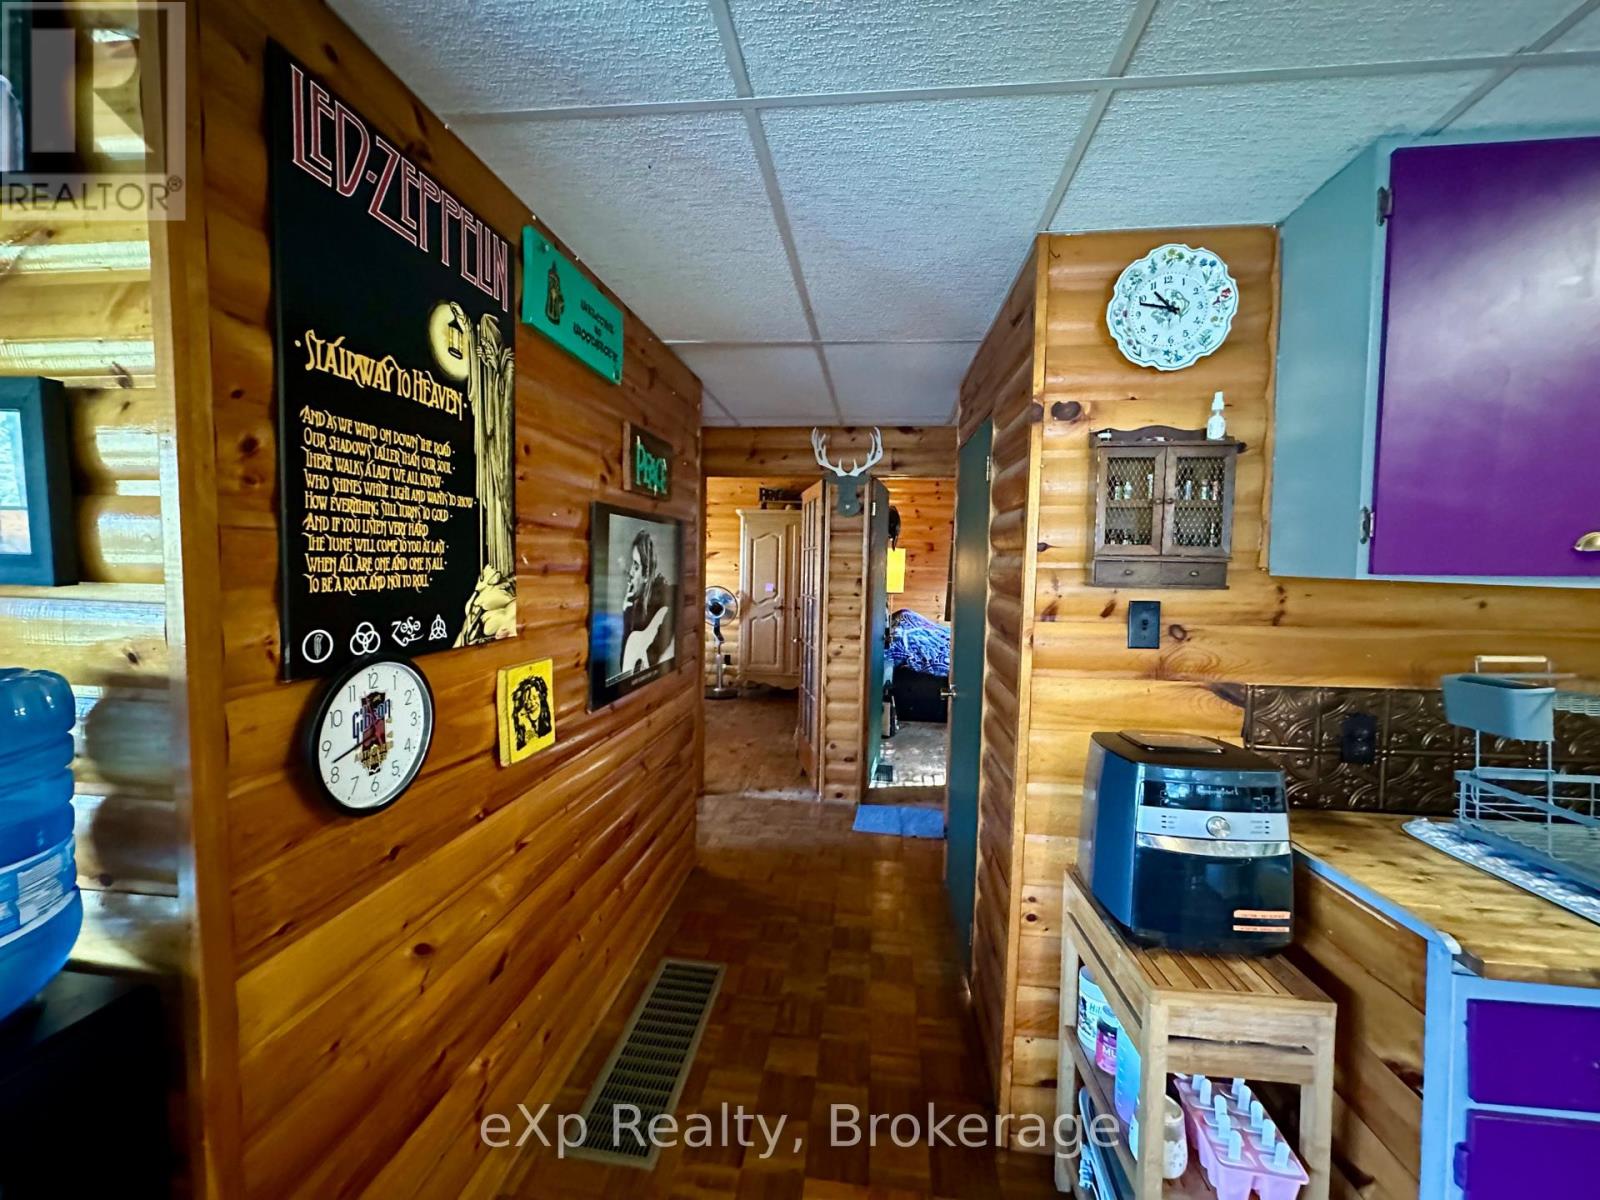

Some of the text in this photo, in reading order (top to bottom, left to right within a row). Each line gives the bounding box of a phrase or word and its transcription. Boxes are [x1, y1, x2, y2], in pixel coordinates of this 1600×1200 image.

[1163, 275, 1173, 285] 12
[1193, 287, 1199, 295] 2
[1152, 334, 1158, 343] 7
[1168, 335, 1174, 344] 6
[1182, 330, 1189, 338] 5
[304, 329, 463, 421] STAIRWAY TO HEAVEN
[300, 404, 326, 428] AND
[323, 409, 338, 433] AS
[337, 416, 353, 435] WE
[353, 420, 378, 440] WIND
[393, 431, 419, 453] DOWN
[303, 426, 331, 455] OUR
[328, 436, 372, 462] SHADOWS
[370, 440, 402, 468] TALLER
[398, 447, 420, 470] THAN
[300, 446, 334, 472] THERE
[334, 456, 364, 480] WALKS
[392, 467, 406, 483] WE
[303, 468, 330, 489] WHO
[332, 477, 362, 497] SHINES
[362, 480, 389, 498] WHITE
[411, 489, 426, 504] AND
[304, 491, 328, 510] HOW
[330, 496, 379, 518] EVERYTHING
[380, 499, 398, 519] STILL
[302, 512, 429, 540] AND IF YOU LISTEN VERY HARD
[301, 531, 326, 552] THE
[324, 533, 353, 552] TUNE
[353, 538, 376, 553] WILL
[376, 539, 398, 553] COME
[304, 552, 337, 577] WHEN
[337, 553, 355, 572] ALL
[353, 553, 373, 576] ARE
[374, 557, 391, 574] ONE
[391, 554, 408, 571] AND
[409, 557, 424, 572] ONE
[302, 573, 320, 594] TO
[321, 577, 334, 593] BE
[343, 576, 368, 596] ROCK
[368, 571, 387, 592] AND
[367, 672, 379, 690] 12
[392, 675, 398, 690] 1
[348, 685, 356, 702] 11
[404, 689, 412, 706] 2
[329, 709, 343, 729] 10
[410, 711, 418, 726] 3
[321, 740, 332, 758] 9
[404, 738, 411, 752] 4
[330, 766, 340, 784] 8
[391, 760, 401, 776] 5
[351, 775, 360, 795] 7
[370, 776, 380, 792] 6
